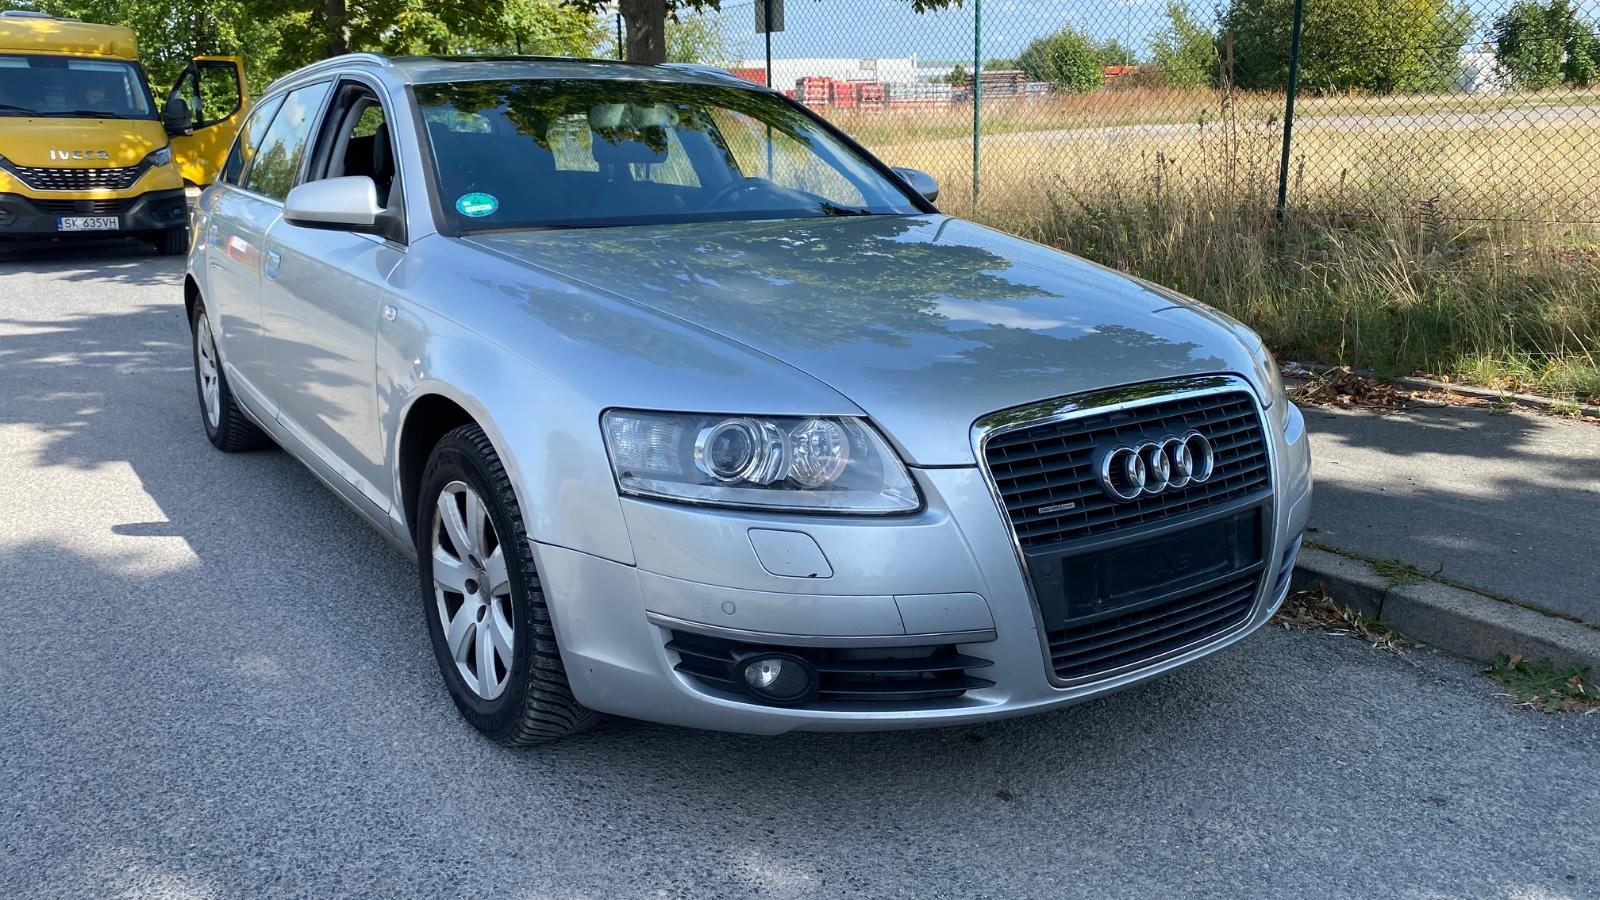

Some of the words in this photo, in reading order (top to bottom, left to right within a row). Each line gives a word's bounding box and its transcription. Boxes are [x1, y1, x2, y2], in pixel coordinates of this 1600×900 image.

[50, 149, 109, 160] IVECO
[64, 218, 79, 228] SK
[83, 217, 117, 228] 635VH
